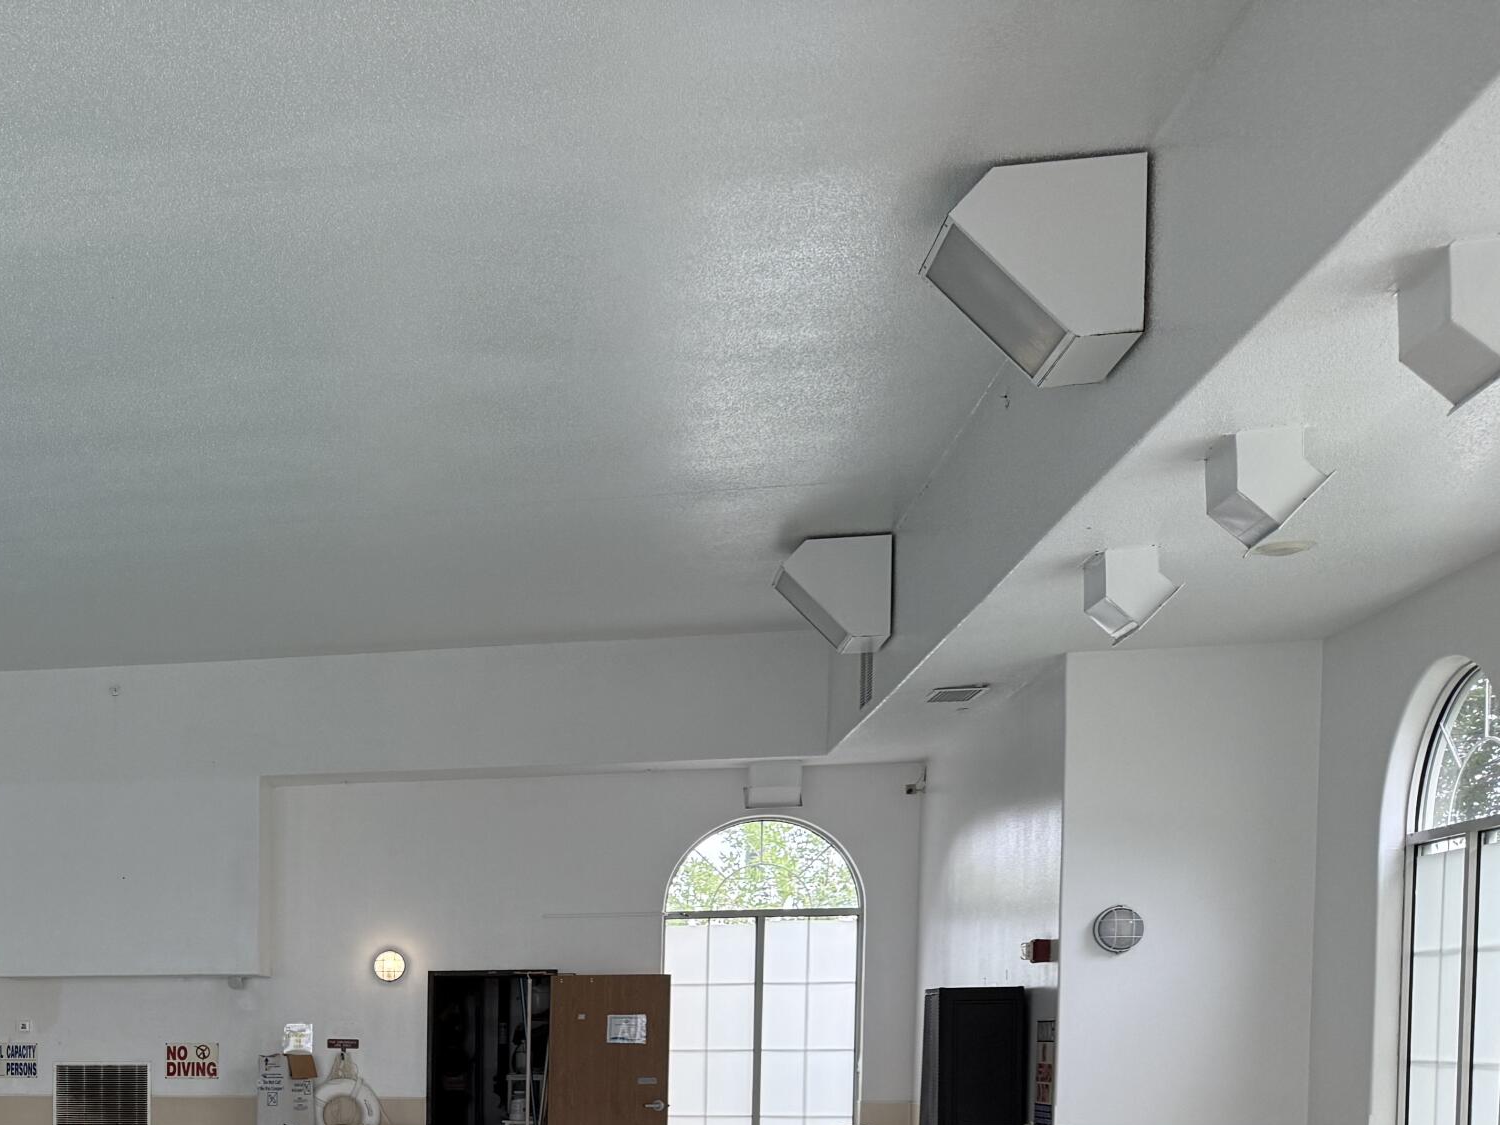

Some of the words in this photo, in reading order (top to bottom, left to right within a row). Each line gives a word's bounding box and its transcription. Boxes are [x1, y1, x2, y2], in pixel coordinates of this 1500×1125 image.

[6, 1045, 36, 1059] CAPACITY
[167, 1045, 188, 1061] NO
[6, 1062, 37, 1076] PERSONS
[166, 1061, 218, 1077] DIVING
